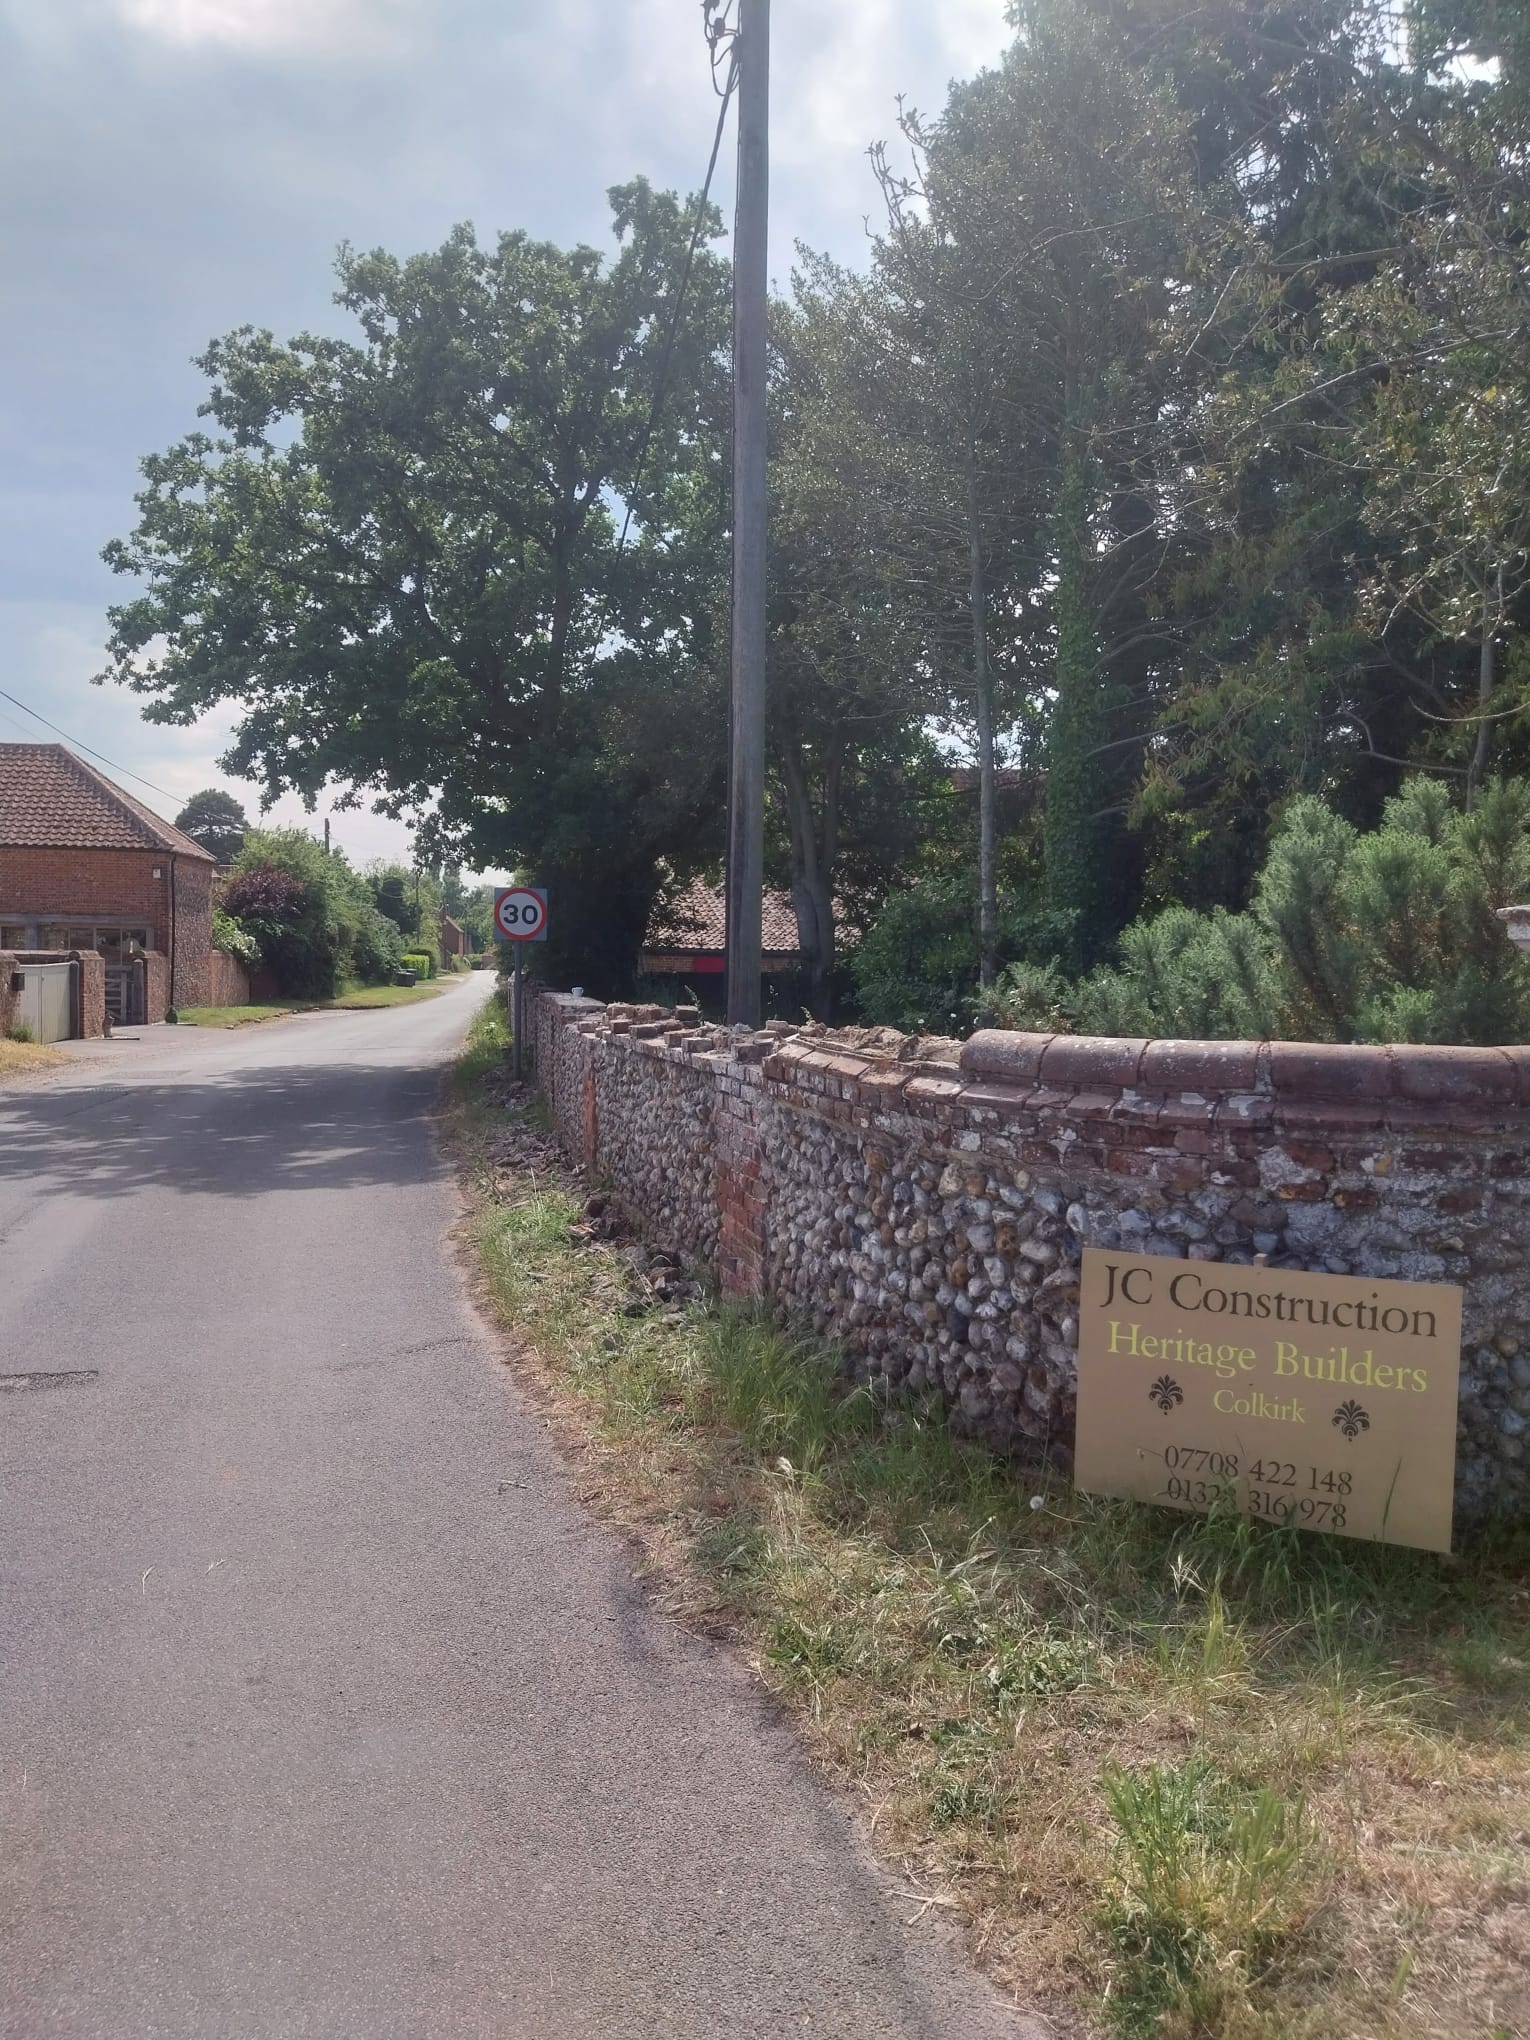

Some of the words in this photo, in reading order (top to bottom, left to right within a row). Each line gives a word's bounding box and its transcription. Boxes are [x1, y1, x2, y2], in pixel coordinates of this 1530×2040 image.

[503, 904, 538, 924] 30
[1100, 1265, 1152, 1308] JC
[1169, 1273, 1437, 1337] Construction
[1107, 1321, 1257, 1378] Heritage
[1273, 1341, 1428, 1393] Builders
[1213, 1389, 1306, 1423] Colkirk
[1165, 1445, 1239, 1478] 07708
[1248, 1459, 1297, 1486] 422
[1308, 1467, 1353, 1496] 148
[1168, 1477, 1237, 1508] 0132
[1247, 1490, 1288, 1518] 316
[1300, 1498, 1347, 1528] 978
